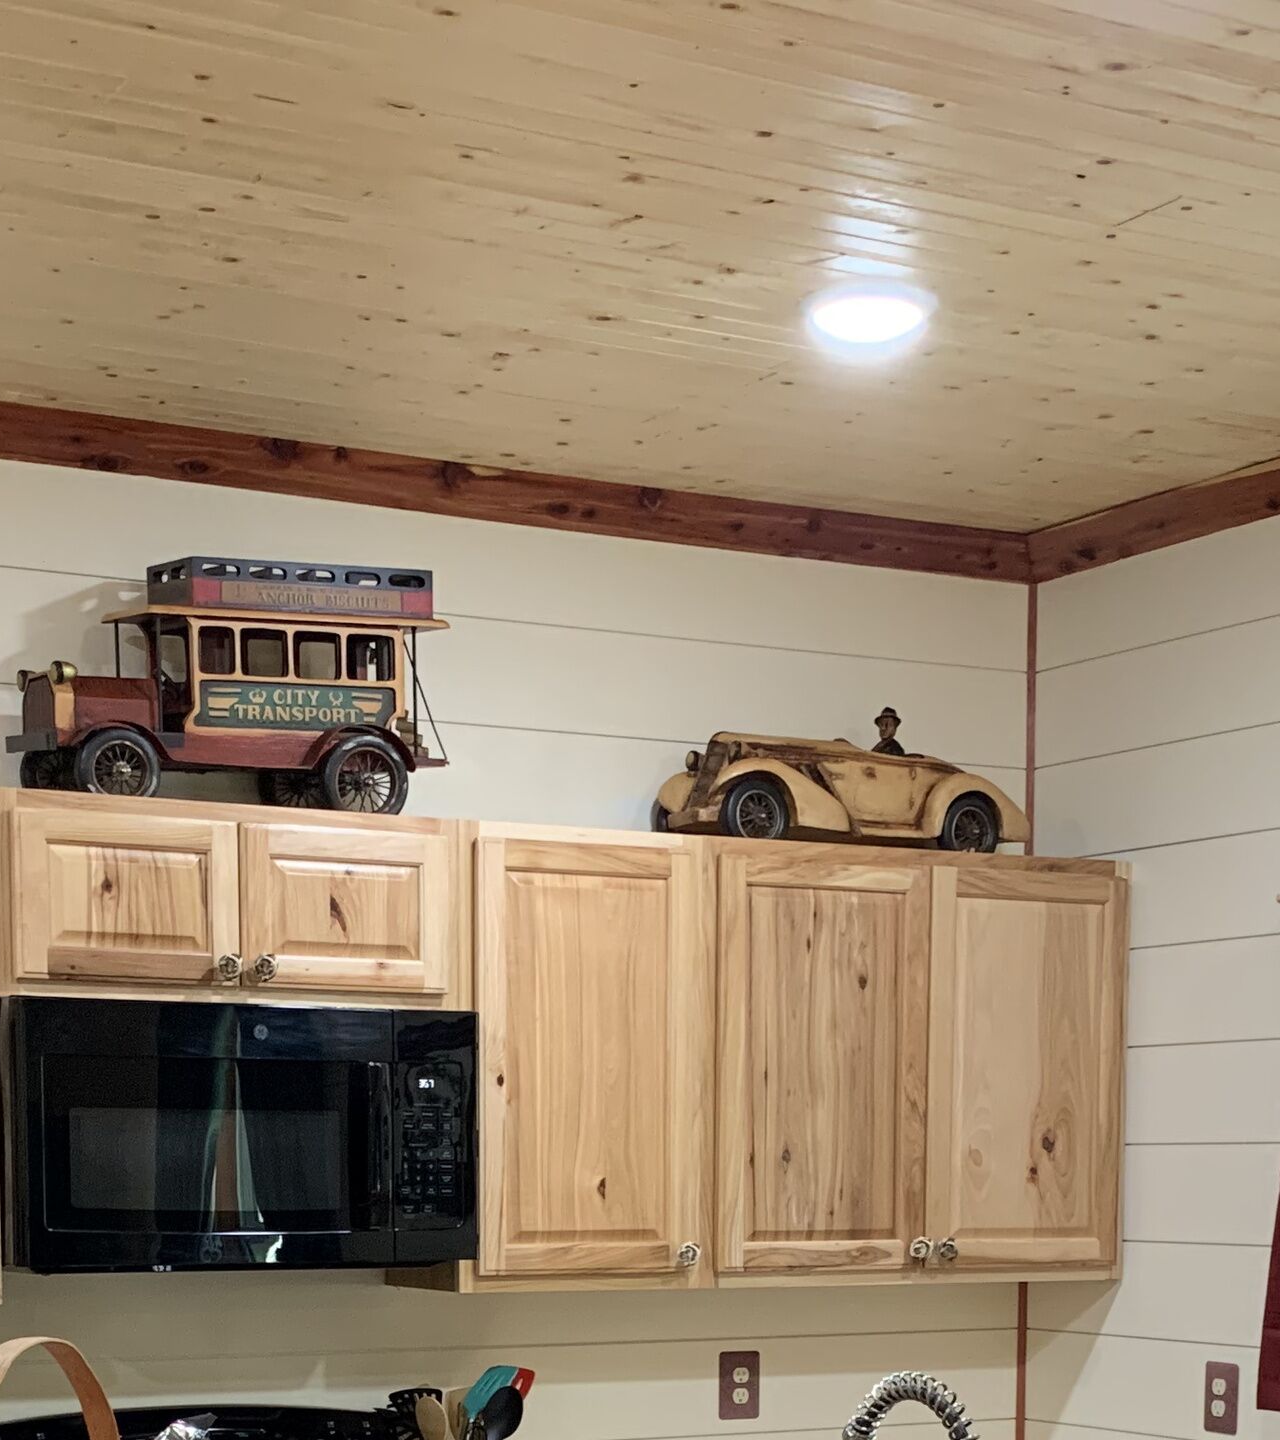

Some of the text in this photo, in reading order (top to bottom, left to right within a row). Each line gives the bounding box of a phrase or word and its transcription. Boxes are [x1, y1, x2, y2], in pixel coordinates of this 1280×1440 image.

[257, 591, 315, 606] ANCHOR
[273, 688, 321, 706] CITY
[233, 703, 360, 723] TRANSPORT
